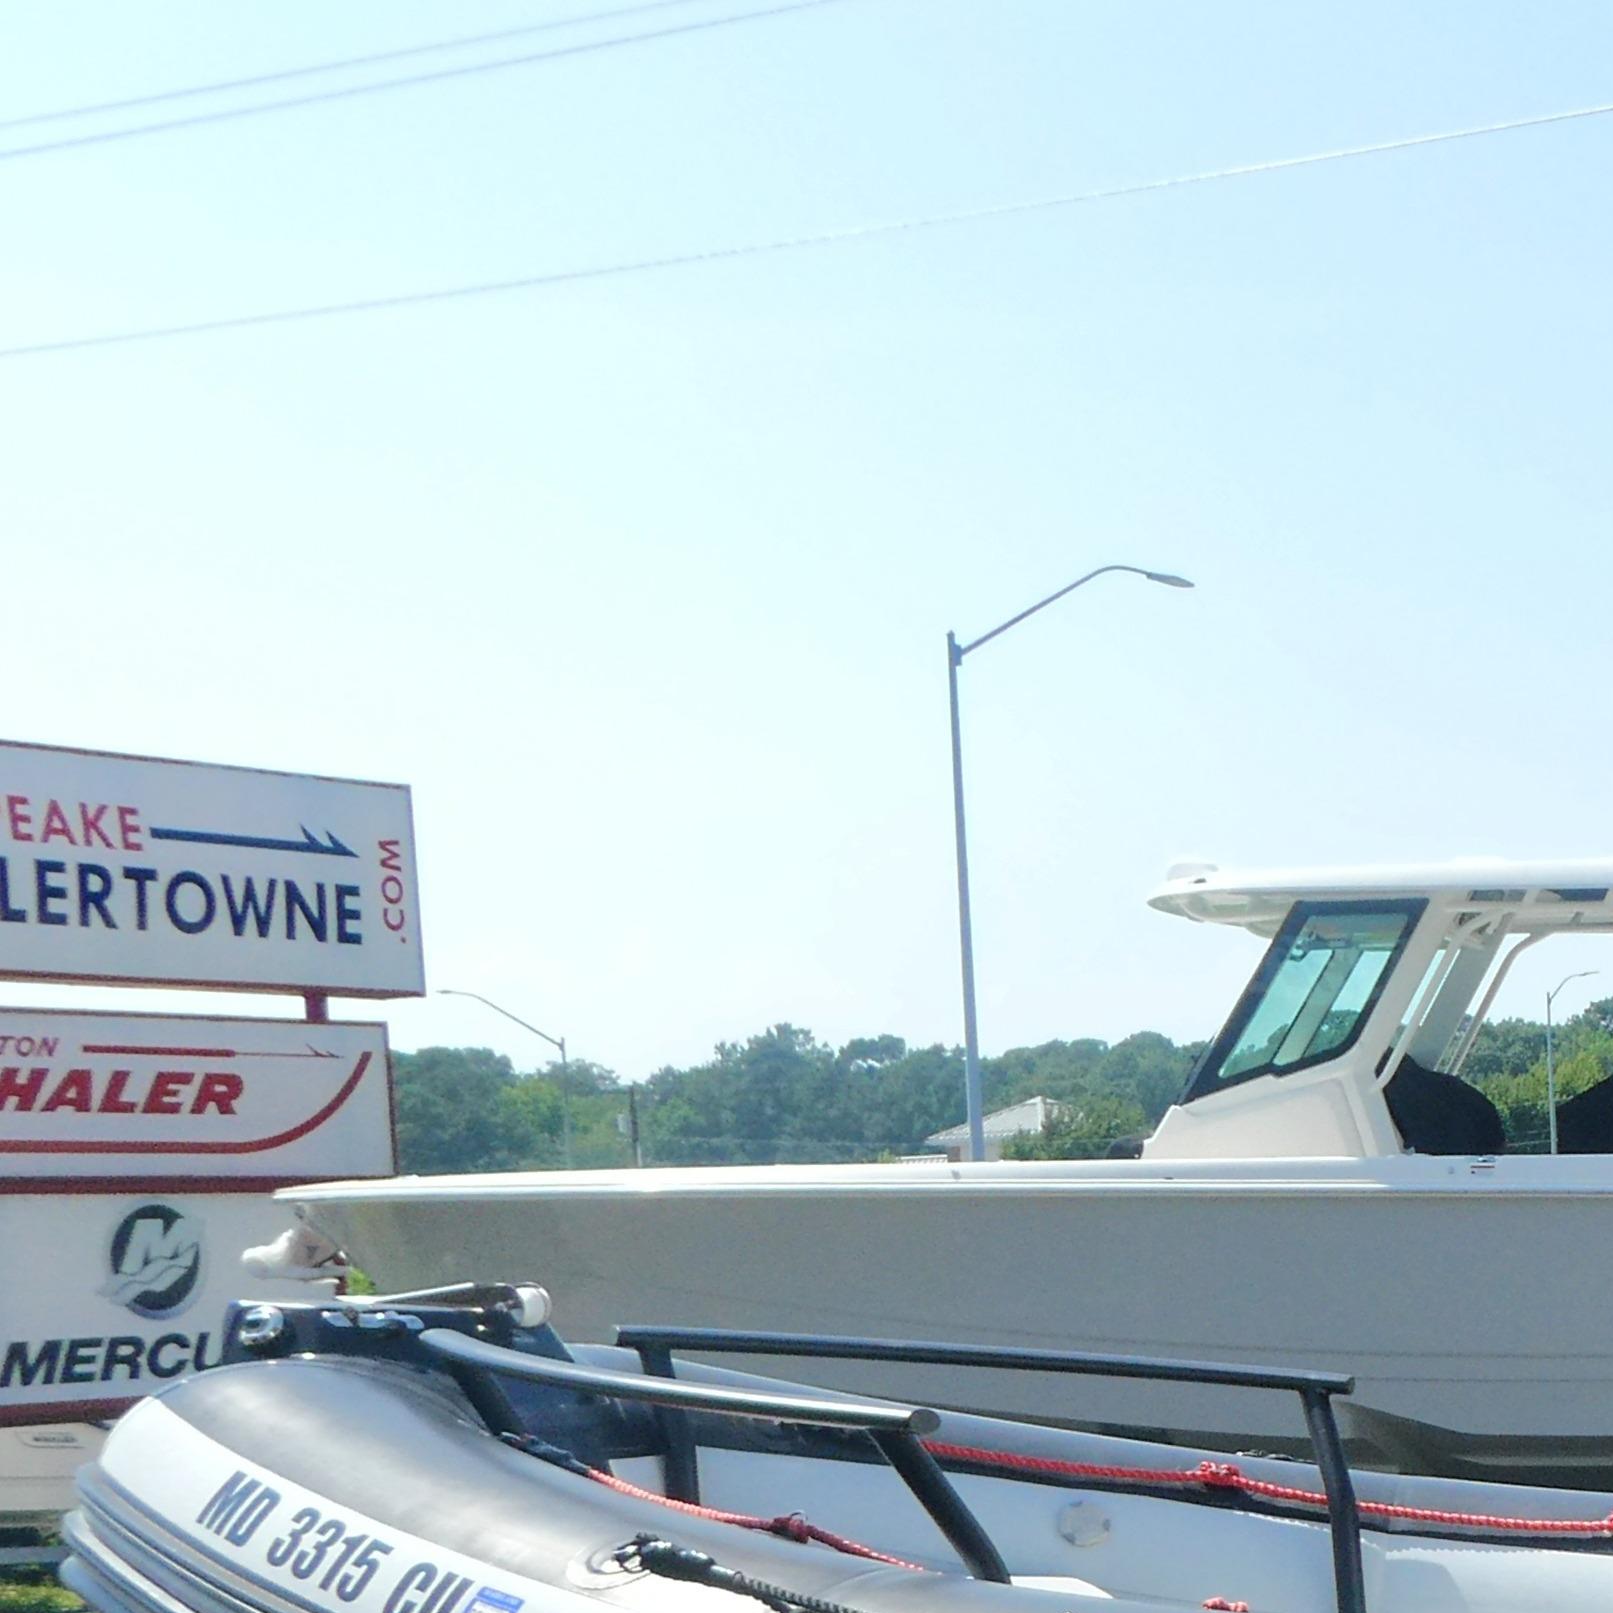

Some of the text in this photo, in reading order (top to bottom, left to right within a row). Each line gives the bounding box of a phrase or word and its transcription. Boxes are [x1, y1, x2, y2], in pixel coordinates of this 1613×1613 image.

[0, 794, 144, 852] EAKE
[0, 856, 363, 945] LERTOWNE
[377, 839, 407, 944] .COM
[0, 1035, 59, 1058] TON
[0, 1066, 244, 1116] HALER
[195, 1470, 281, 1547] MD
[266, 1507, 395, 1603] 3315
